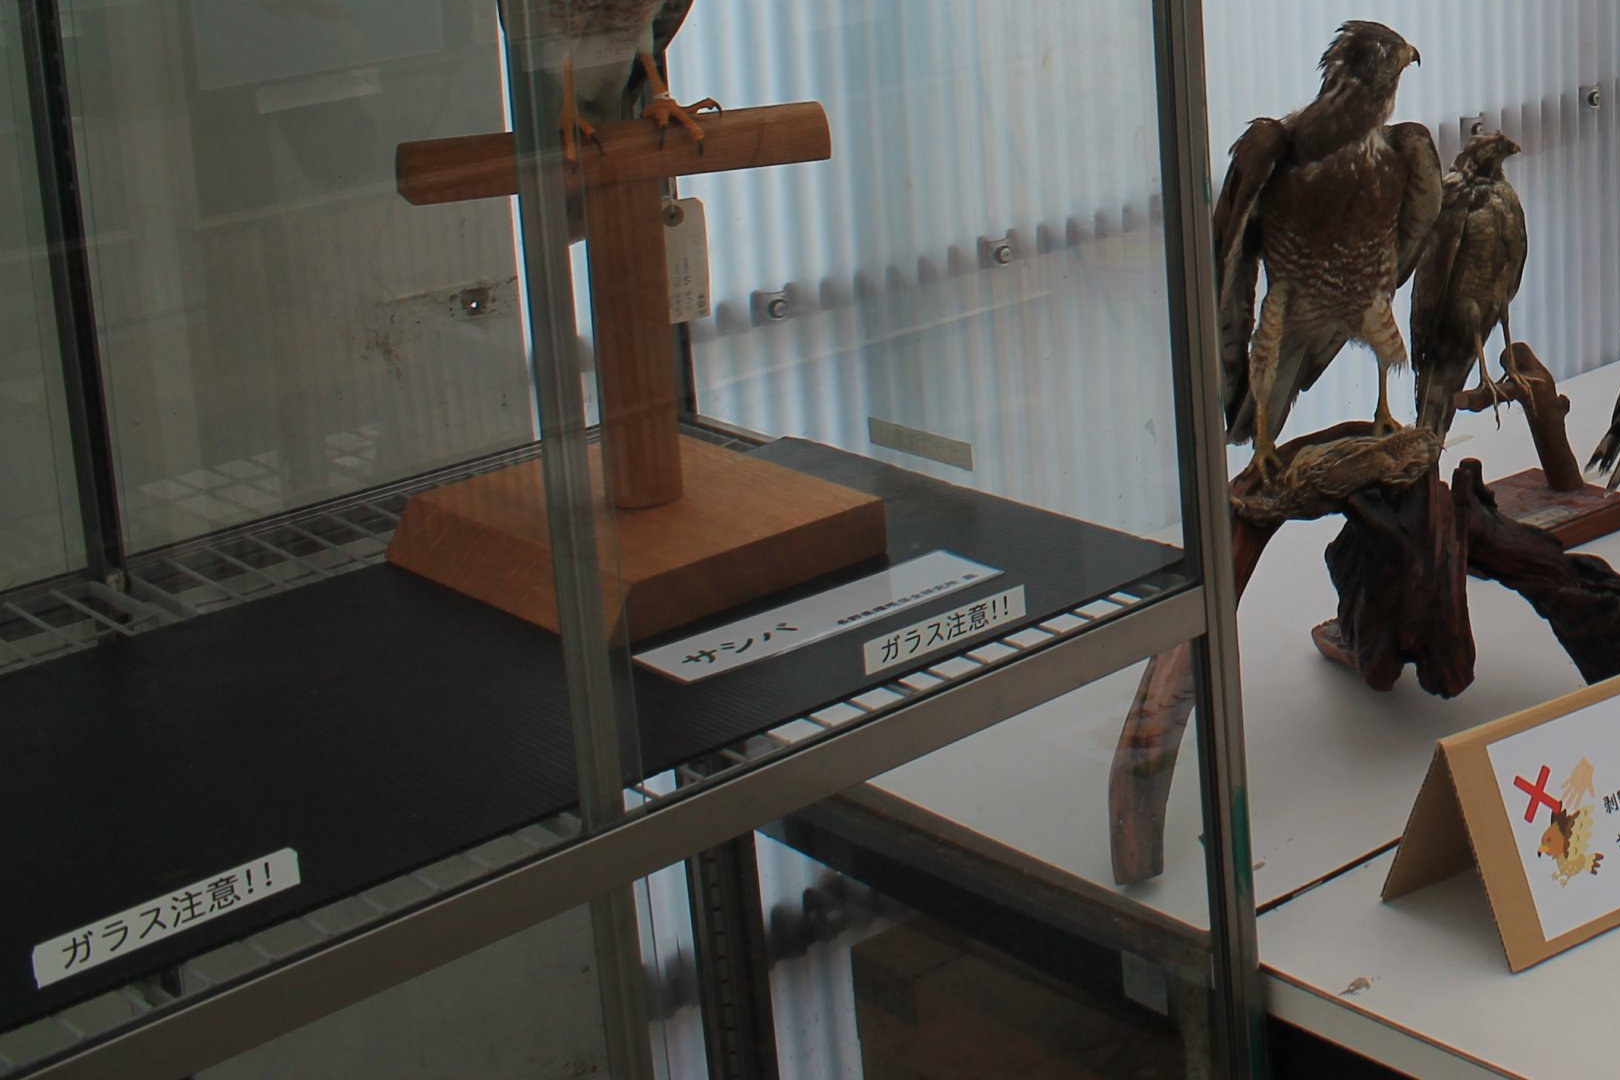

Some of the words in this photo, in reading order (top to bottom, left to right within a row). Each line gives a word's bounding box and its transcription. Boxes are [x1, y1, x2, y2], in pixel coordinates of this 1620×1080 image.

[681, 621, 799, 666] サシバ
[881, 595, 1010, 664] ガラス注意!!
[61, 861, 273, 969] ガラス注意!!
